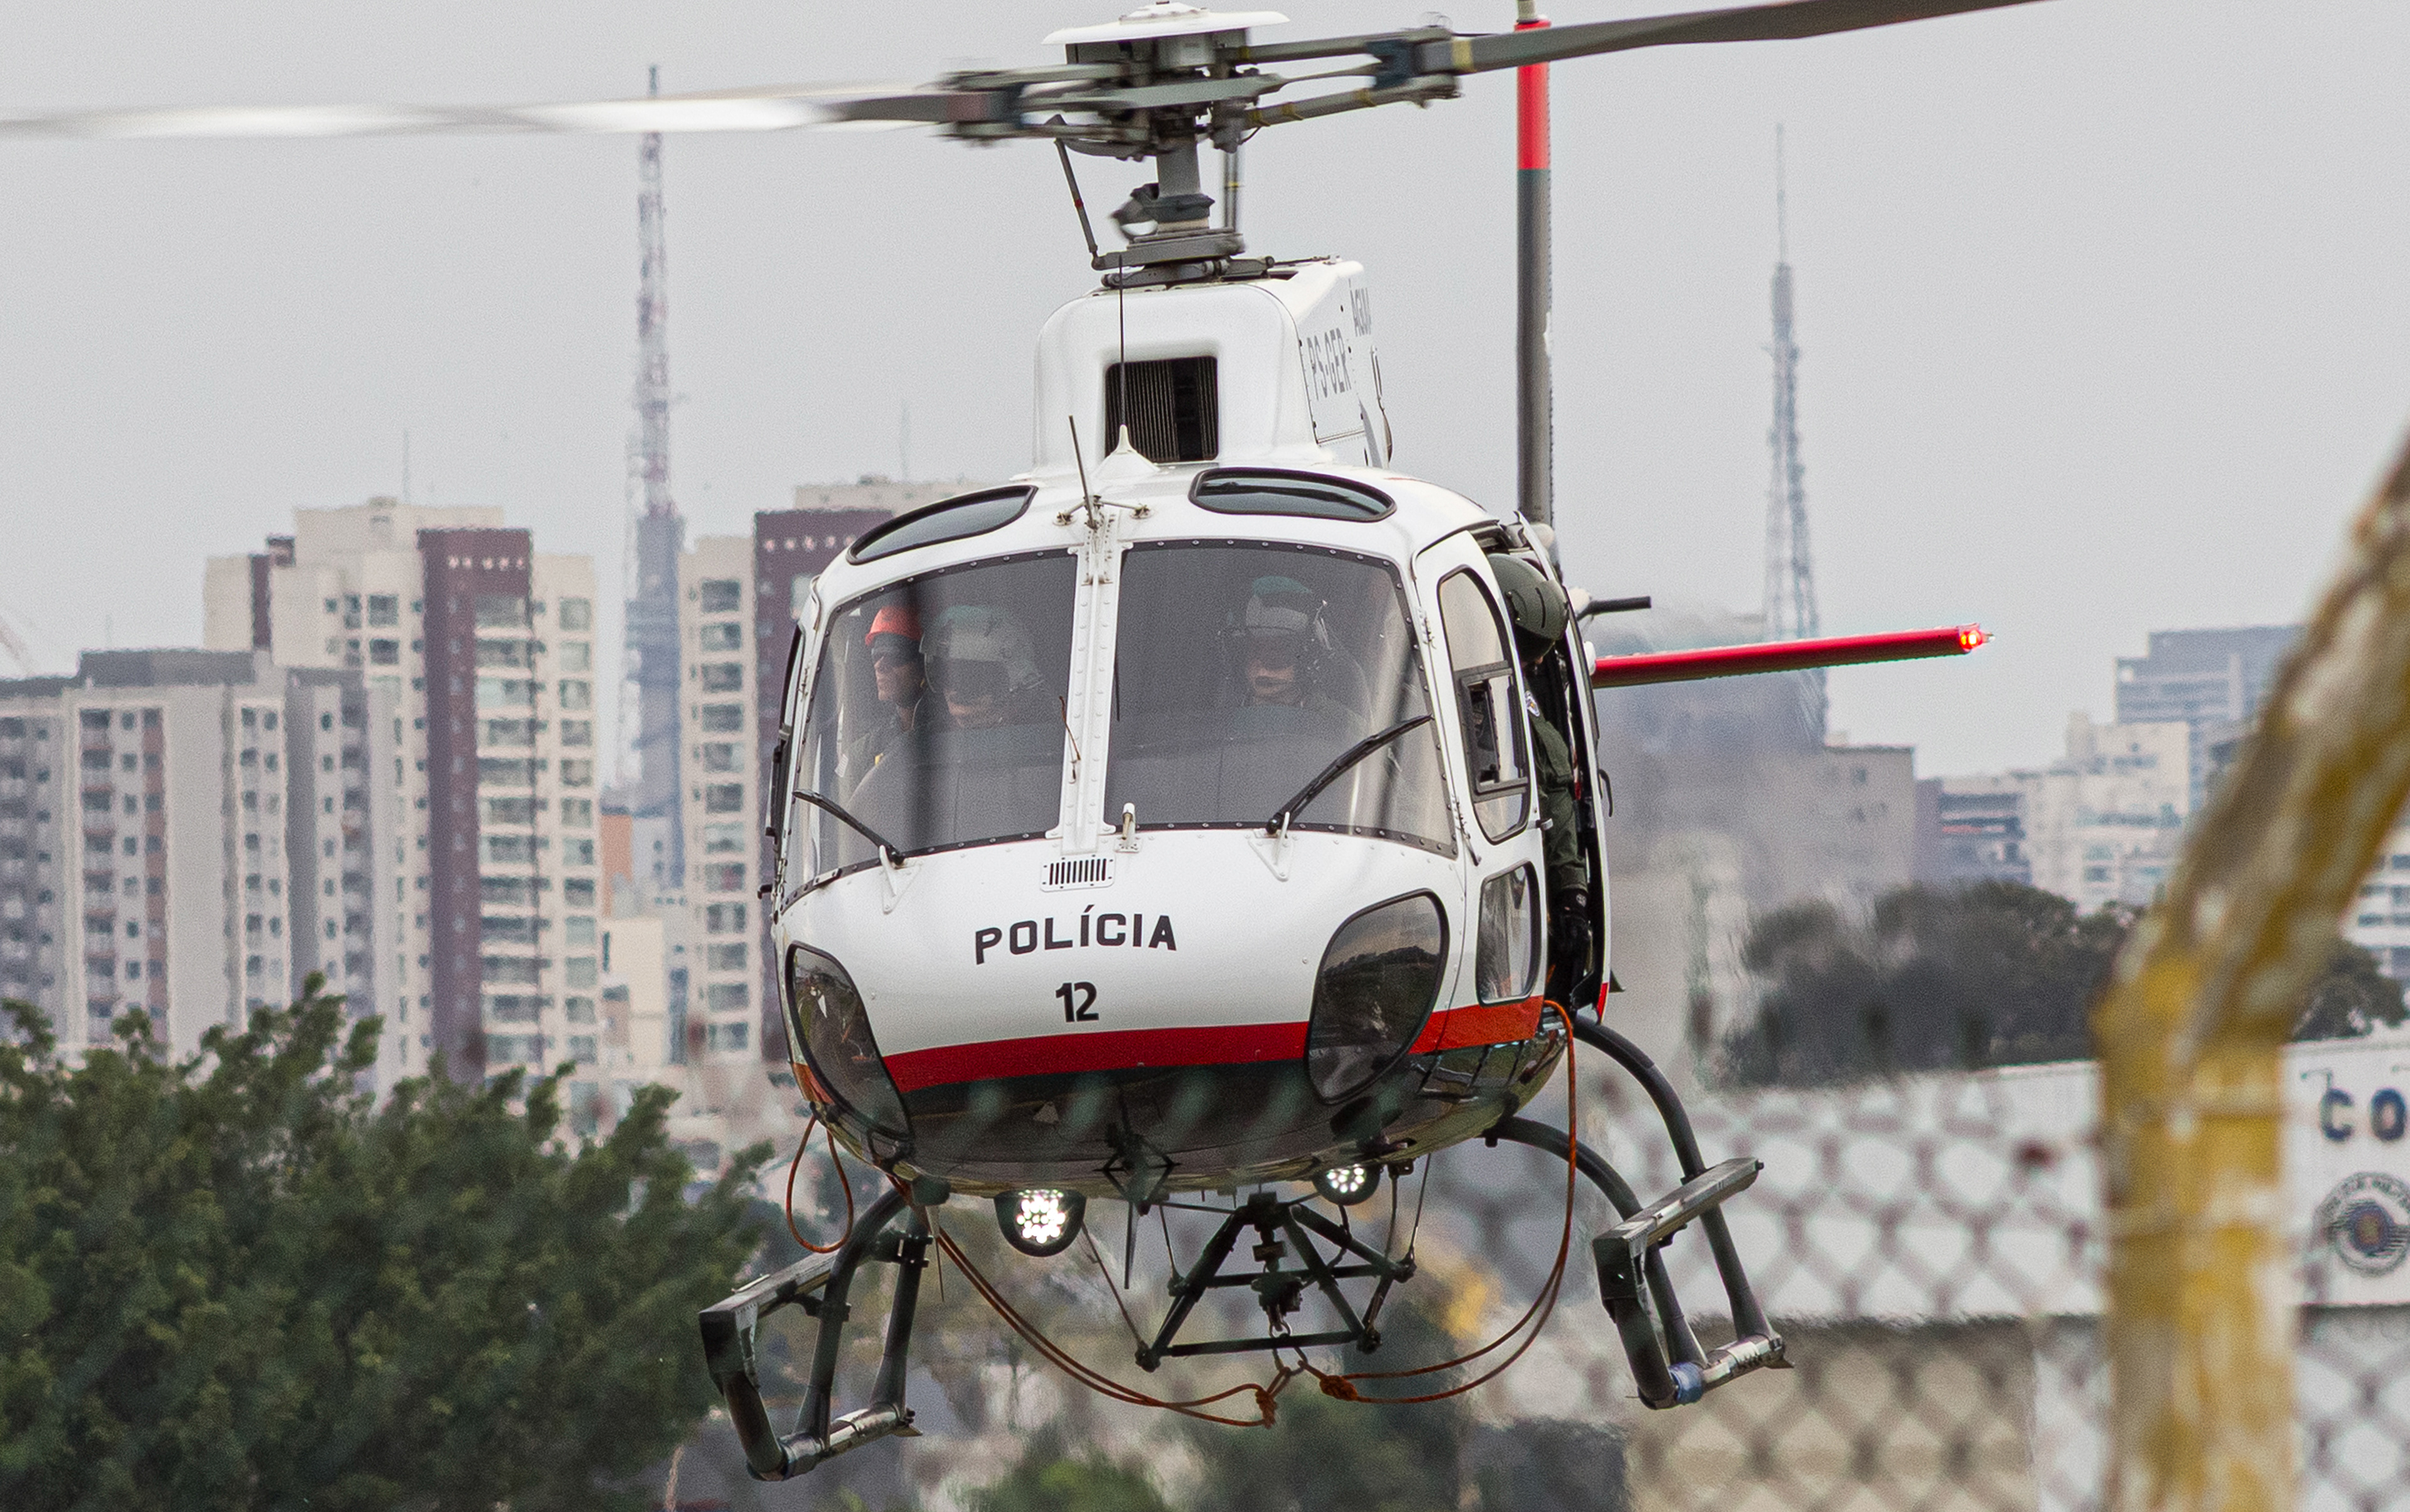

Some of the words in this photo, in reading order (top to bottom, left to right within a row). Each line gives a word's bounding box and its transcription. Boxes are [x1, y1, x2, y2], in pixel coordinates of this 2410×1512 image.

[1307, 327, 1352, 400] PS-GER
[975, 904, 1177, 965] POLÍCIA
[1055, 981, 1100, 1023] 12
